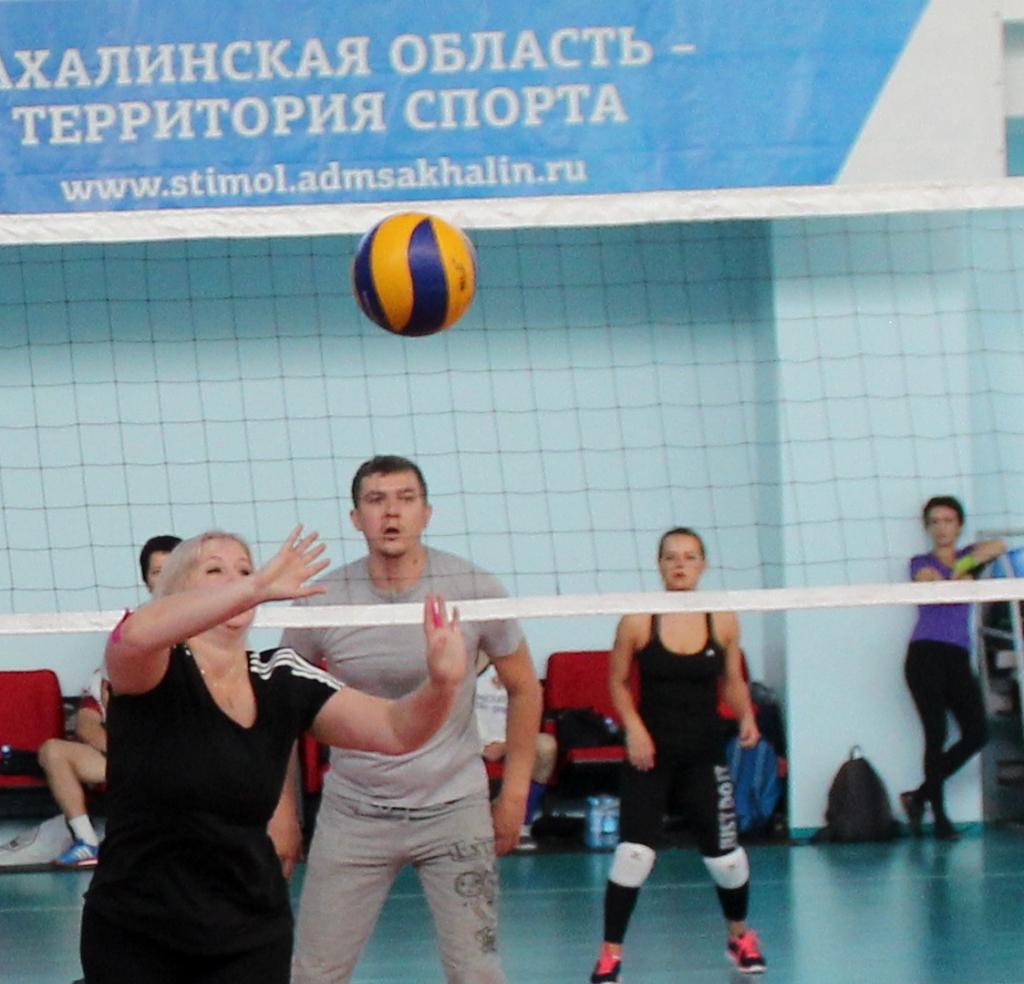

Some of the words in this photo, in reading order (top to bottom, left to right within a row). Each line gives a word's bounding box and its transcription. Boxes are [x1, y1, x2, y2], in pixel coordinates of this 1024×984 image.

[389, 26, 653, 76] ОБЛАСТЬ
[11, 92, 386, 145] ТЕРРИТОРИЯ
[405, 83, 629, 130] СПОРТА
[61, 155, 587, 201] www.stimol.admsakhalin.ru
